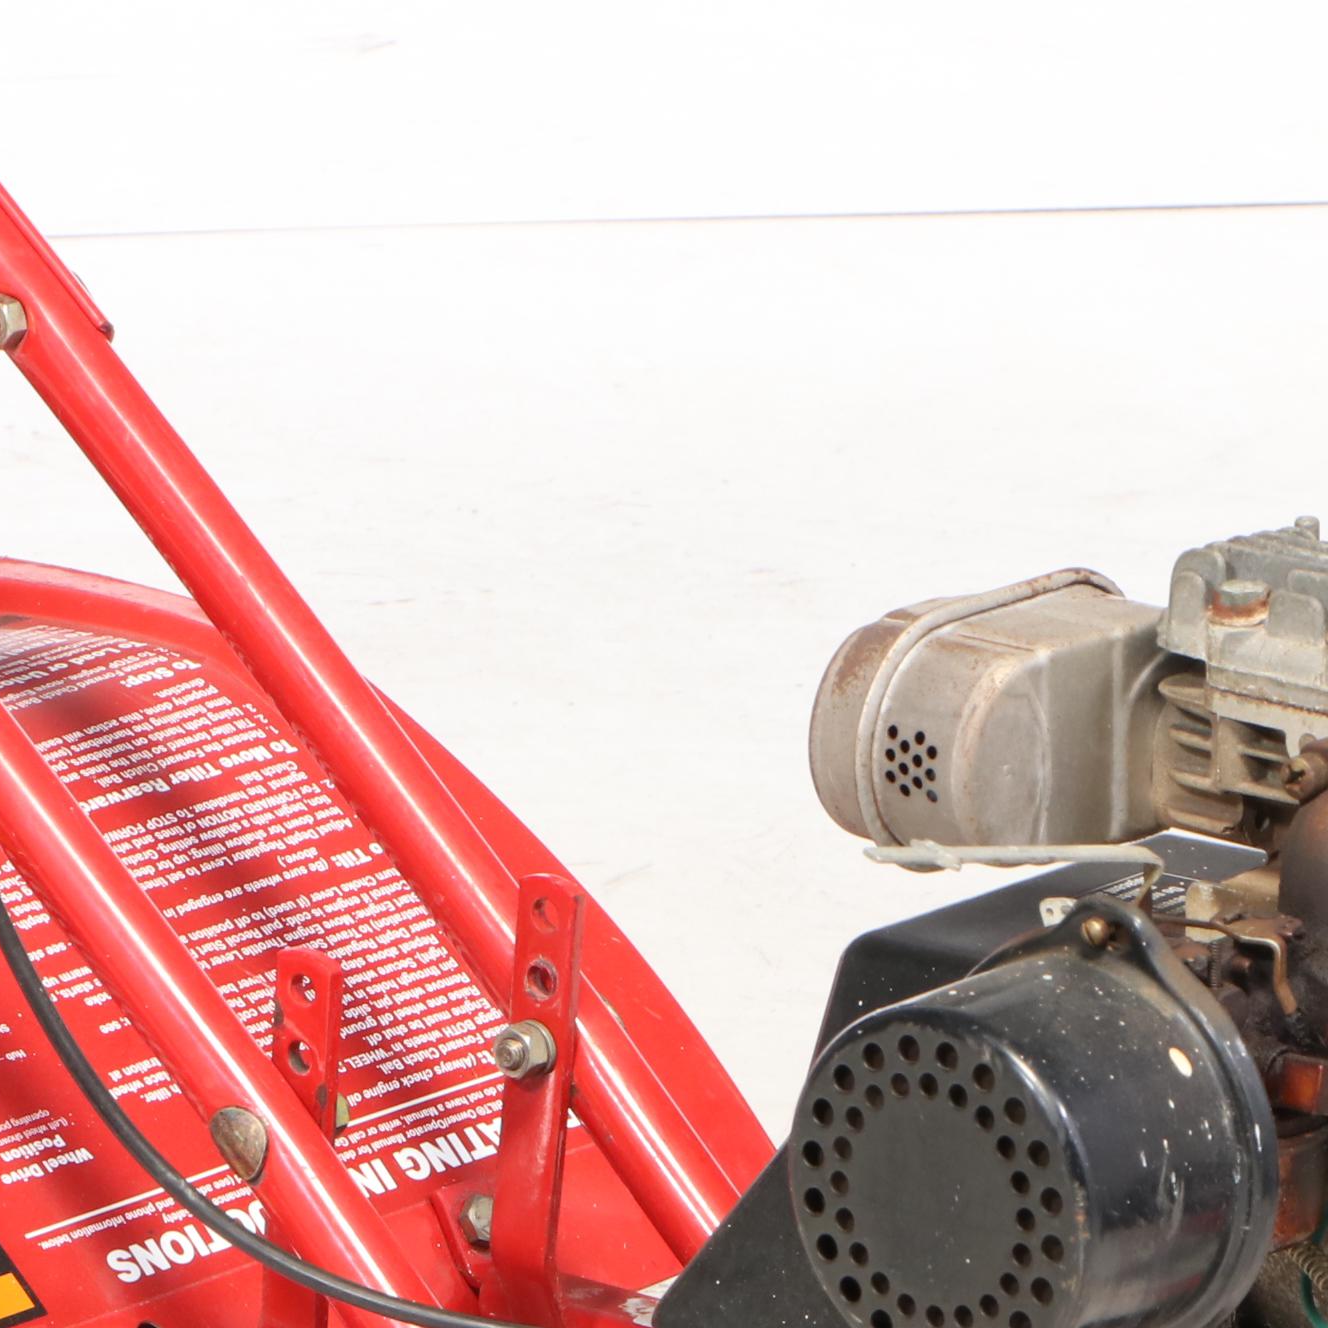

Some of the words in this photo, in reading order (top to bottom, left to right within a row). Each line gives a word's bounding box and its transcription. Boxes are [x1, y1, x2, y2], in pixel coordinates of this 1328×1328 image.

[171, 658, 202, 670] To
[119, 666, 174, 688] Stop:
[217, 744, 273, 768] Move
[268, 738, 298, 754] To
[168, 761, 223, 785] Tiller
[450, 996, 491, 1016] Engine
[406, 1018, 426, 1030] be
[421, 1009, 452, 1027] must
[362, 1032, 382, 1046] off.
[381, 1023, 409, 1040] shut
[0, 1133, 66, 1162] Position
[41, 1147, 94, 1173] Wheel
[0, 1162, 45, 1184] Drive
